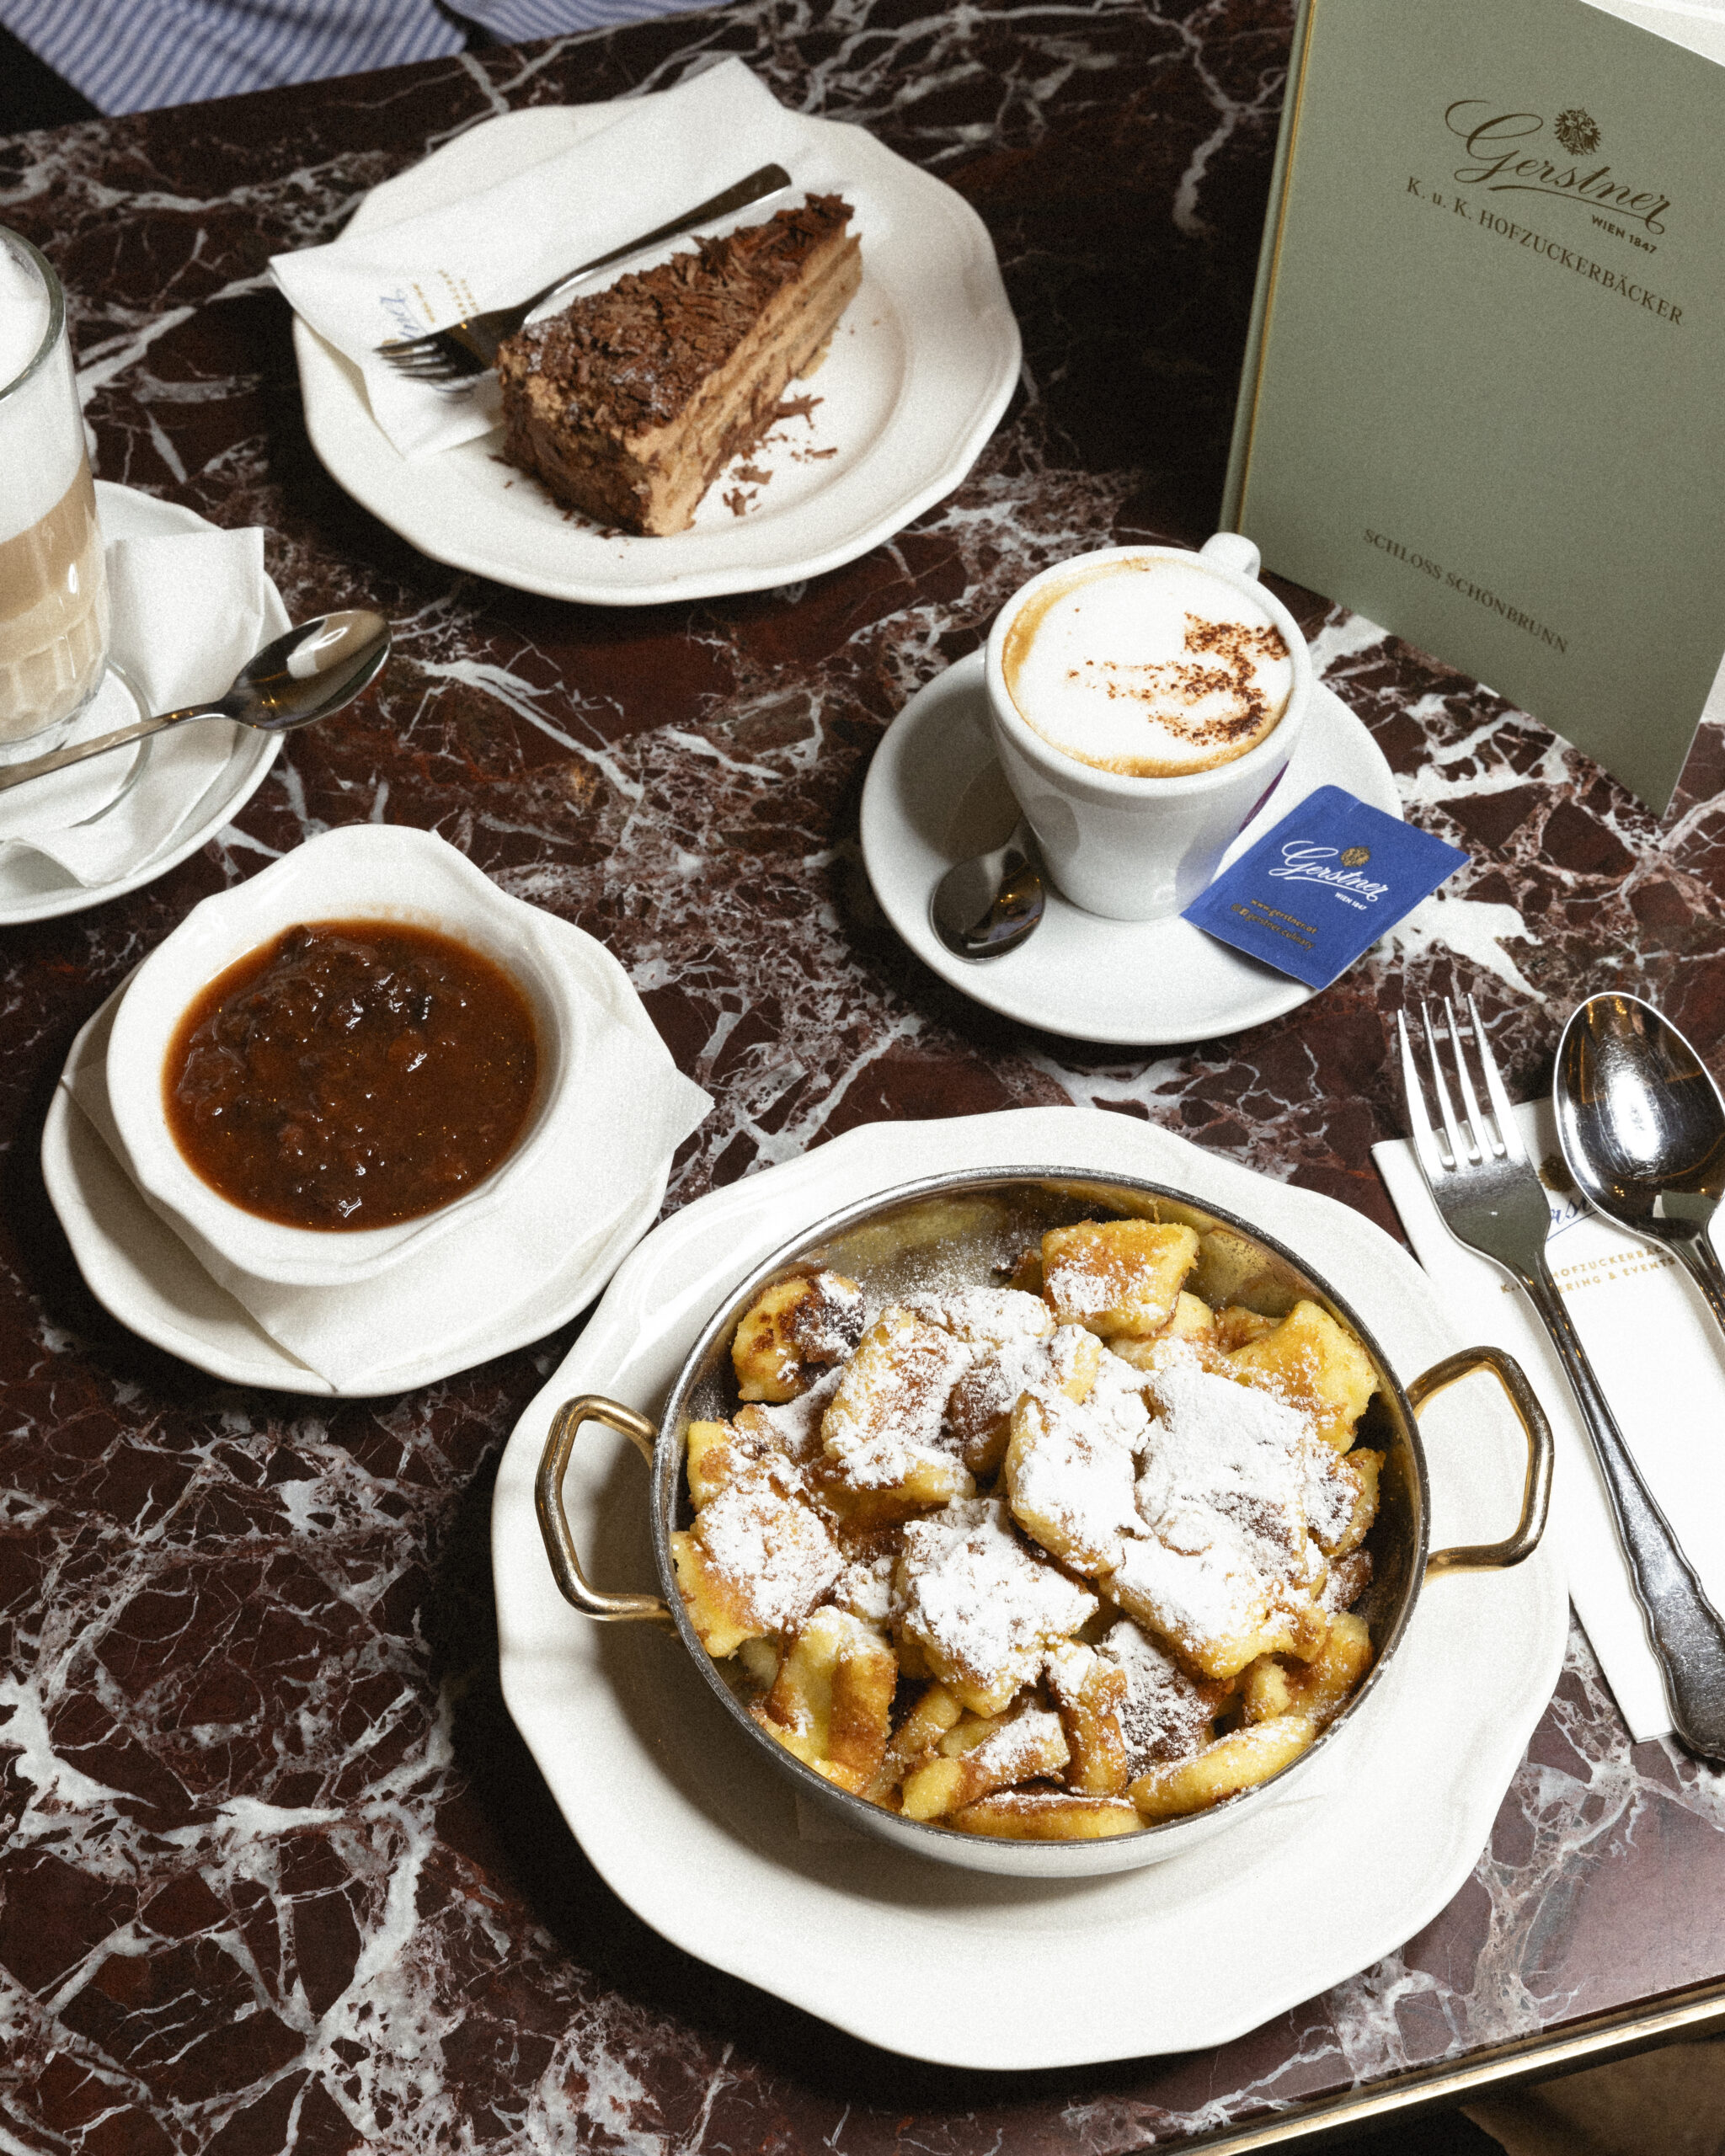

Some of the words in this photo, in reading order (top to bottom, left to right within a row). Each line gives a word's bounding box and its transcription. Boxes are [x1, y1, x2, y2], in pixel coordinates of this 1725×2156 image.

[1445, 99, 1672, 235] Gerstner
[1406, 175, 1426, 200] K.
[1432, 191, 1447, 207] u.
[1453, 197, 1472, 221] K.
[1479, 209, 1684, 326] HOFZUCKERBÄCKER
[1591, 214, 1626, 238] WIEN
[1629, 234, 1658, 253] 1847
[1363, 528, 1443, 580] SCHLOSS
[1446, 572, 1568, 654] SCHÖNBRUNN
[1268, 840, 1389, 902] Gerstner
[1250, 899, 1319, 935] www.gerstner.at
[1334, 891, 1353, 904] WIEN
[1552, 1245, 1665, 1278] HOFZUCKERBÄC
[1557, 1275, 1601, 1294] ERING
[1622, 1256, 1676, 1277] EVENTS
